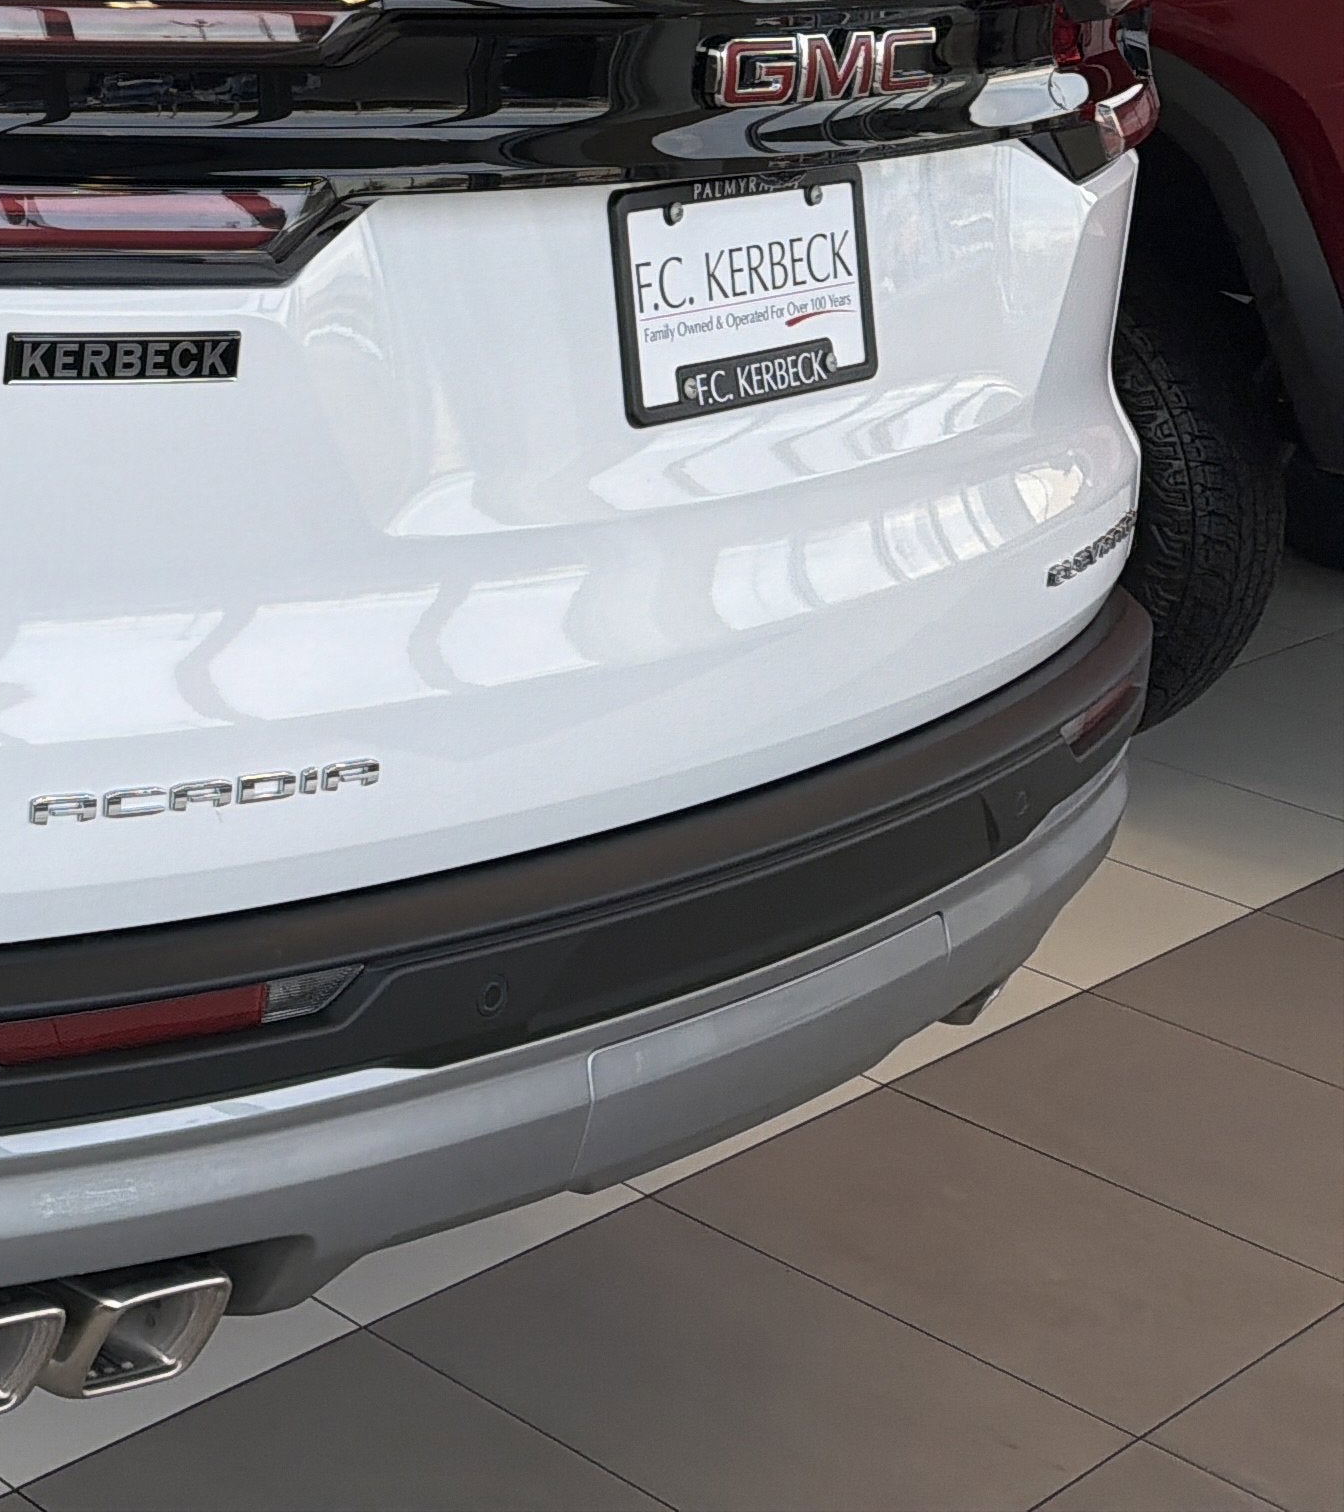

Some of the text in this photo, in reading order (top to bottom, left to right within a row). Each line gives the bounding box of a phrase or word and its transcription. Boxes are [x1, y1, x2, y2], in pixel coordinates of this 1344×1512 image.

[716, 27, 937, 107] GMC
[635, 230, 853, 313] F.C. KERBECK
[644, 294, 852, 343] Family Owned & Operated For Over 100 Years
[21, 341, 230, 377] KERBECK
[695, 350, 827, 406] F.C. KERBECK
[29, 758, 381, 825] ACADIA
